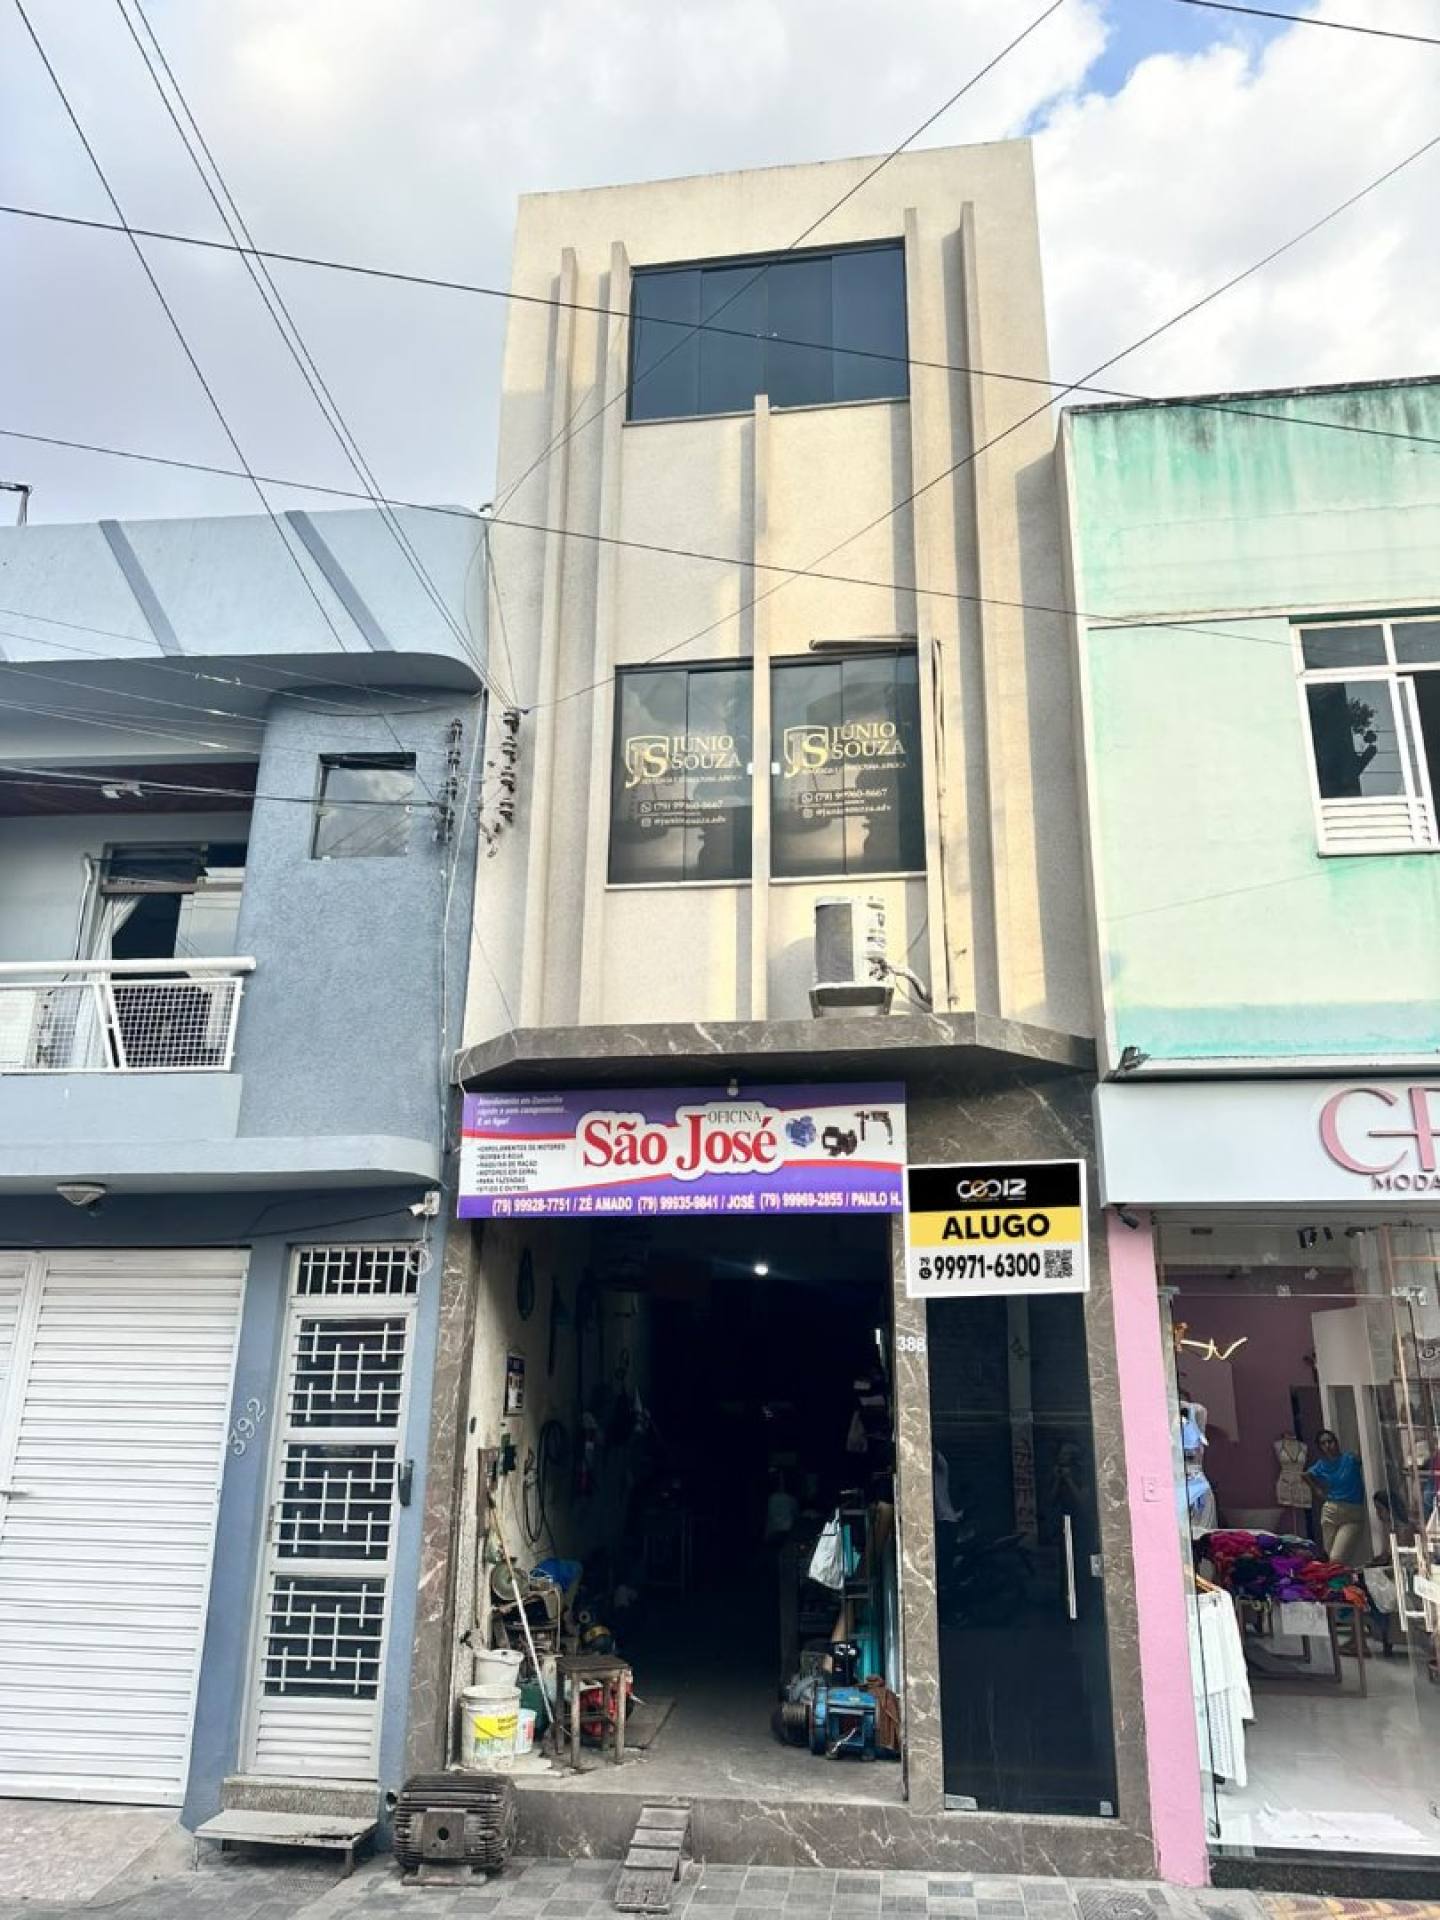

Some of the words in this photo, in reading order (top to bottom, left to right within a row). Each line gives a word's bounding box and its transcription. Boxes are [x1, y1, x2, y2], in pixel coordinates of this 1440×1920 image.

[832, 739, 906, 760] SOUZA
[672, 752, 742, 770] SOUZA
[707, 1110, 763, 1124] OFICINA
[583, 1119, 668, 1167] São
[676, 1114, 777, 1170] José
[492, 1197, 511, 1216] (79)
[579, 1194, 593, 1212] ZÉ
[595, 1196, 632, 1212] AMADO
[637, 1195, 658, 1214] (79)
[727, 1192, 755, 1210] JOSÉ
[761, 1191, 780, 1211] (79)
[851, 1190, 888, 1207] PAULO
[942, 1213, 1050, 1240] ALUGO
[934, 1252, 1041, 1280] 99971-6300
